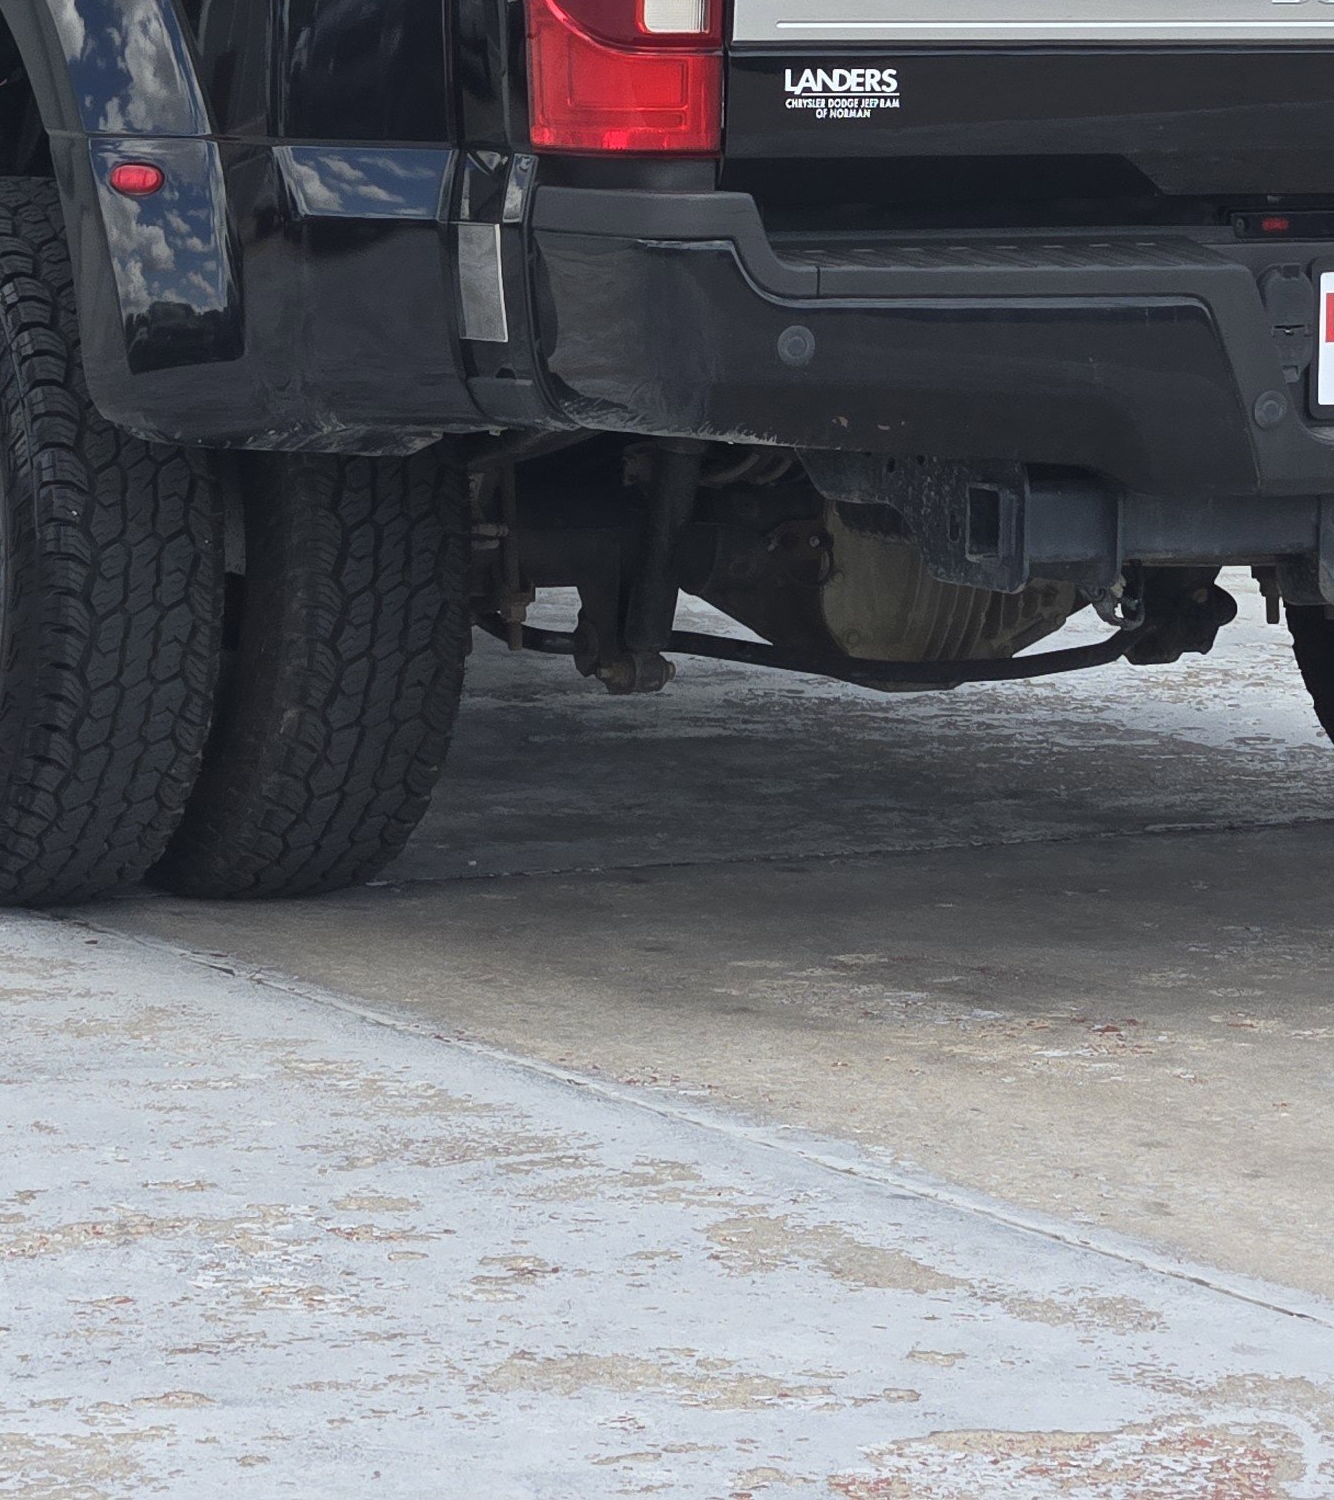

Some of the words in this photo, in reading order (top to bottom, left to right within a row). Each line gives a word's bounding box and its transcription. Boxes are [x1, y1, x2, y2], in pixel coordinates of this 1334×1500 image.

[784, 68, 898, 95] LANDERS
[785, 98, 826, 109] CHRYSLER
[827, 98, 859, 108] DODGE
[860, 98, 879, 108] JEEP
[879, 98, 900, 108] RAM
[815, 108, 828, 119] OF
[828, 108, 872, 118] NORMAN
